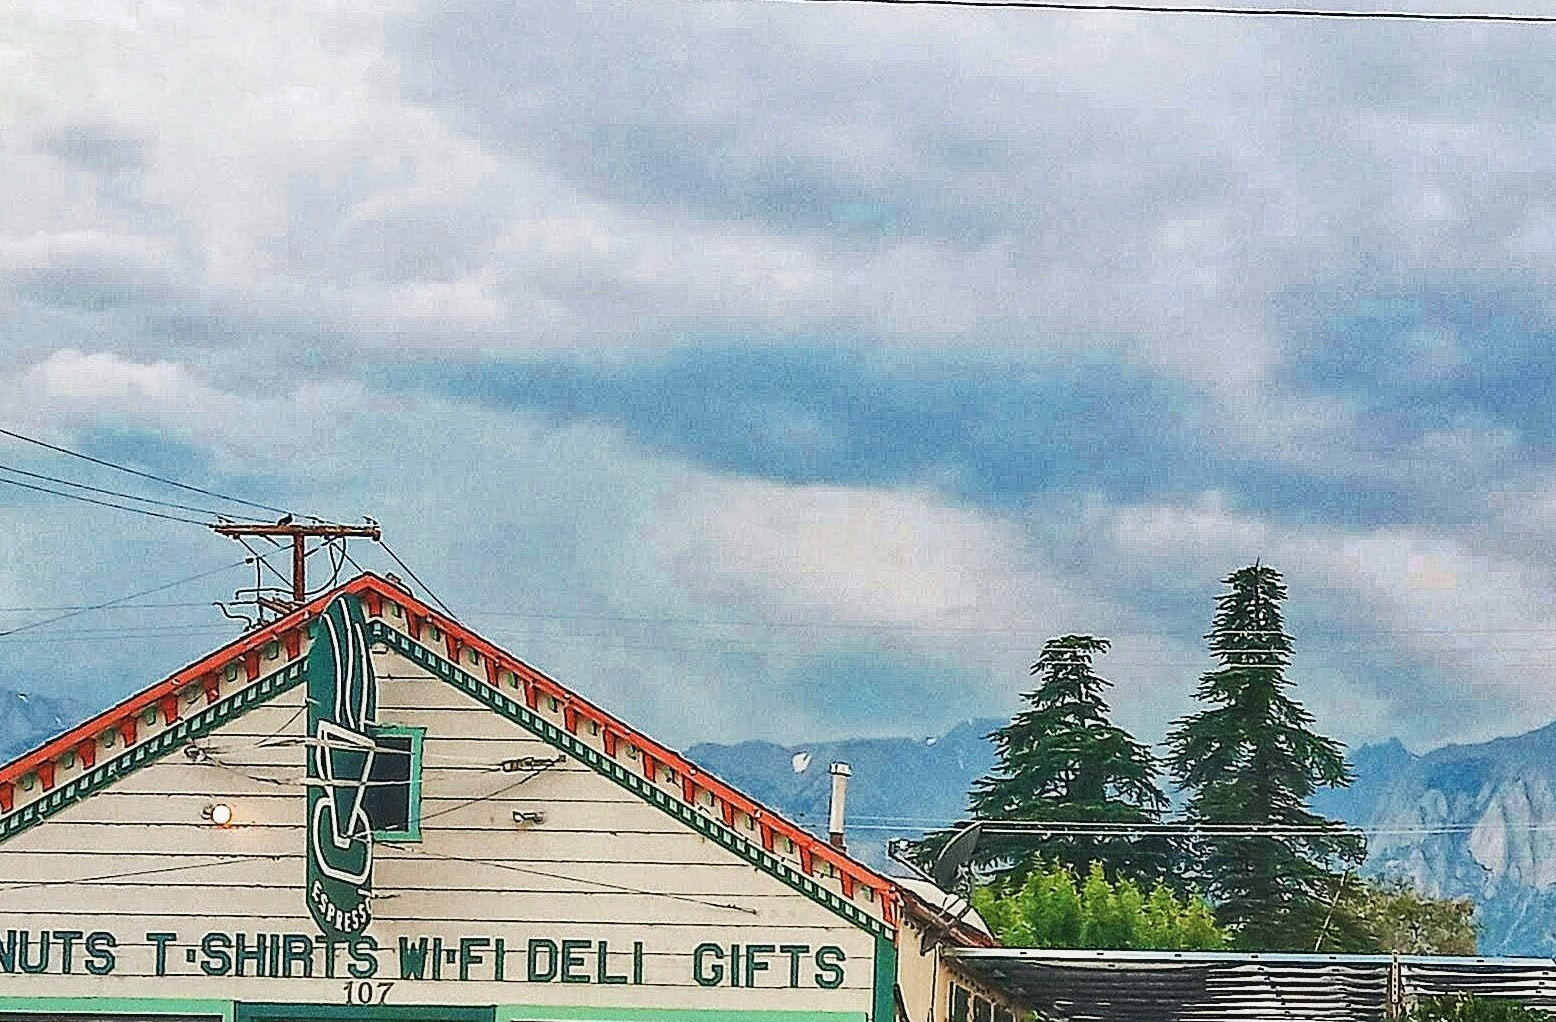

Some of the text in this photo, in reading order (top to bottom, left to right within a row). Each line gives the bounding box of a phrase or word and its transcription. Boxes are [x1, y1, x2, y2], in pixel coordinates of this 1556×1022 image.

[527, 938, 643, 985] DELI
[693, 943, 846, 989] GIFTS
[344, 981, 394, 1004] 107
